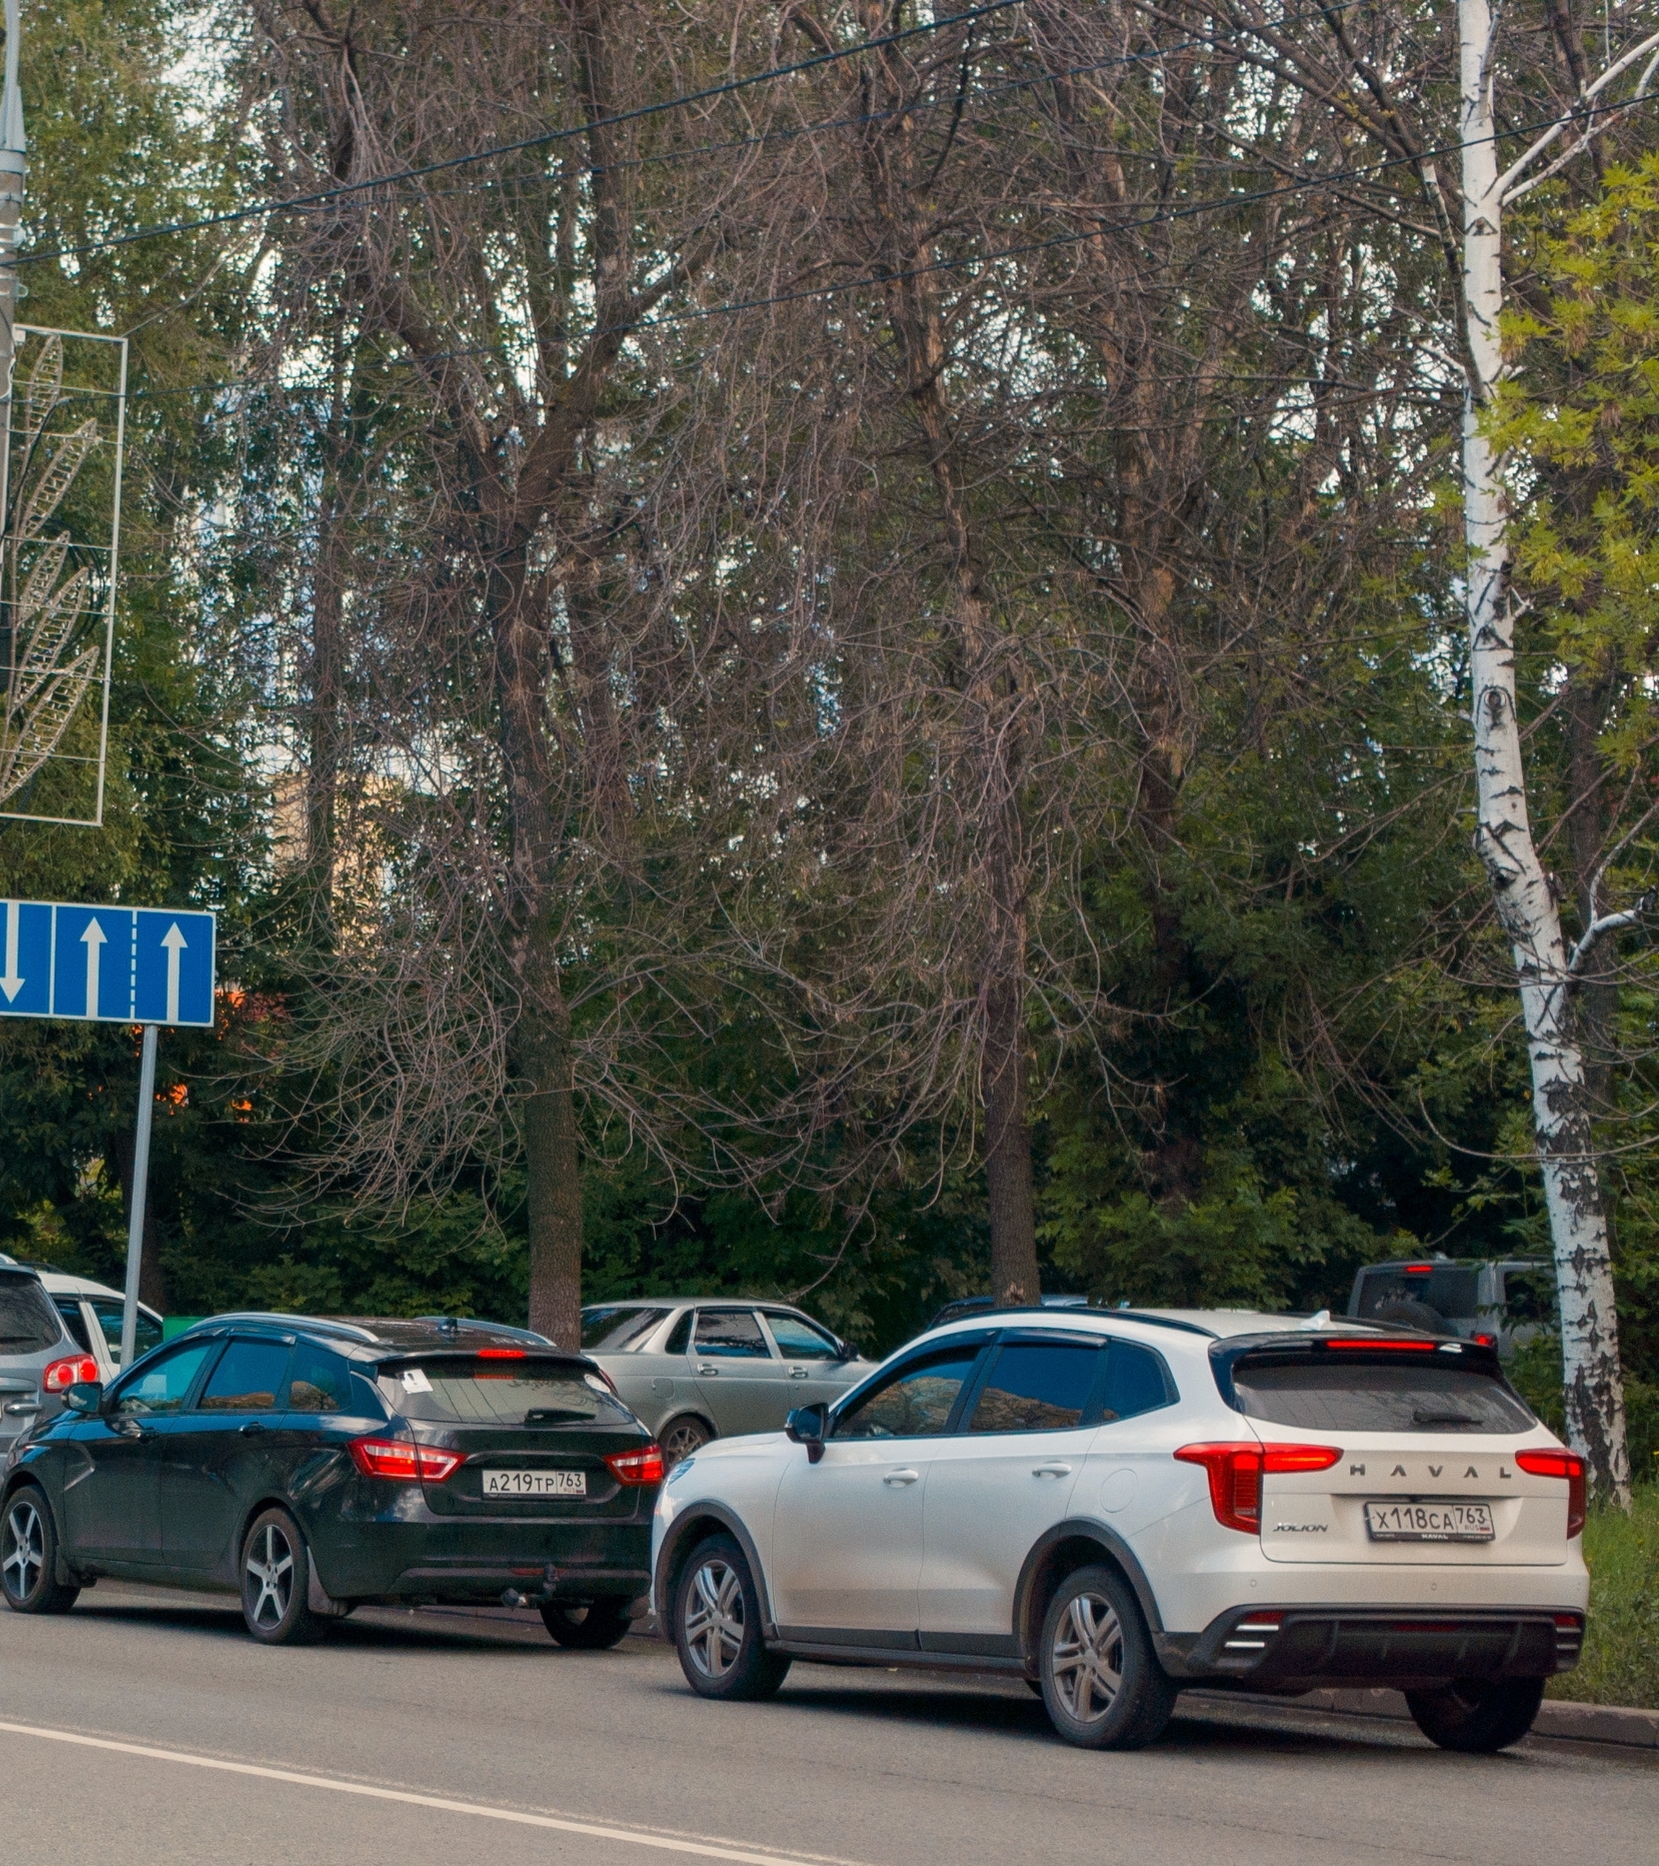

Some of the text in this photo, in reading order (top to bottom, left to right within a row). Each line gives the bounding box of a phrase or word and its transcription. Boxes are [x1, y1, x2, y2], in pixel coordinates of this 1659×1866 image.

[1350, 1464, 1511, 1479] HAVAL
[489, 1473, 582, 1492] А219ТР 763
[1376, 1507, 1486, 1530] Х118СА 763
[1273, 1524, 1329, 1532] JOLION
